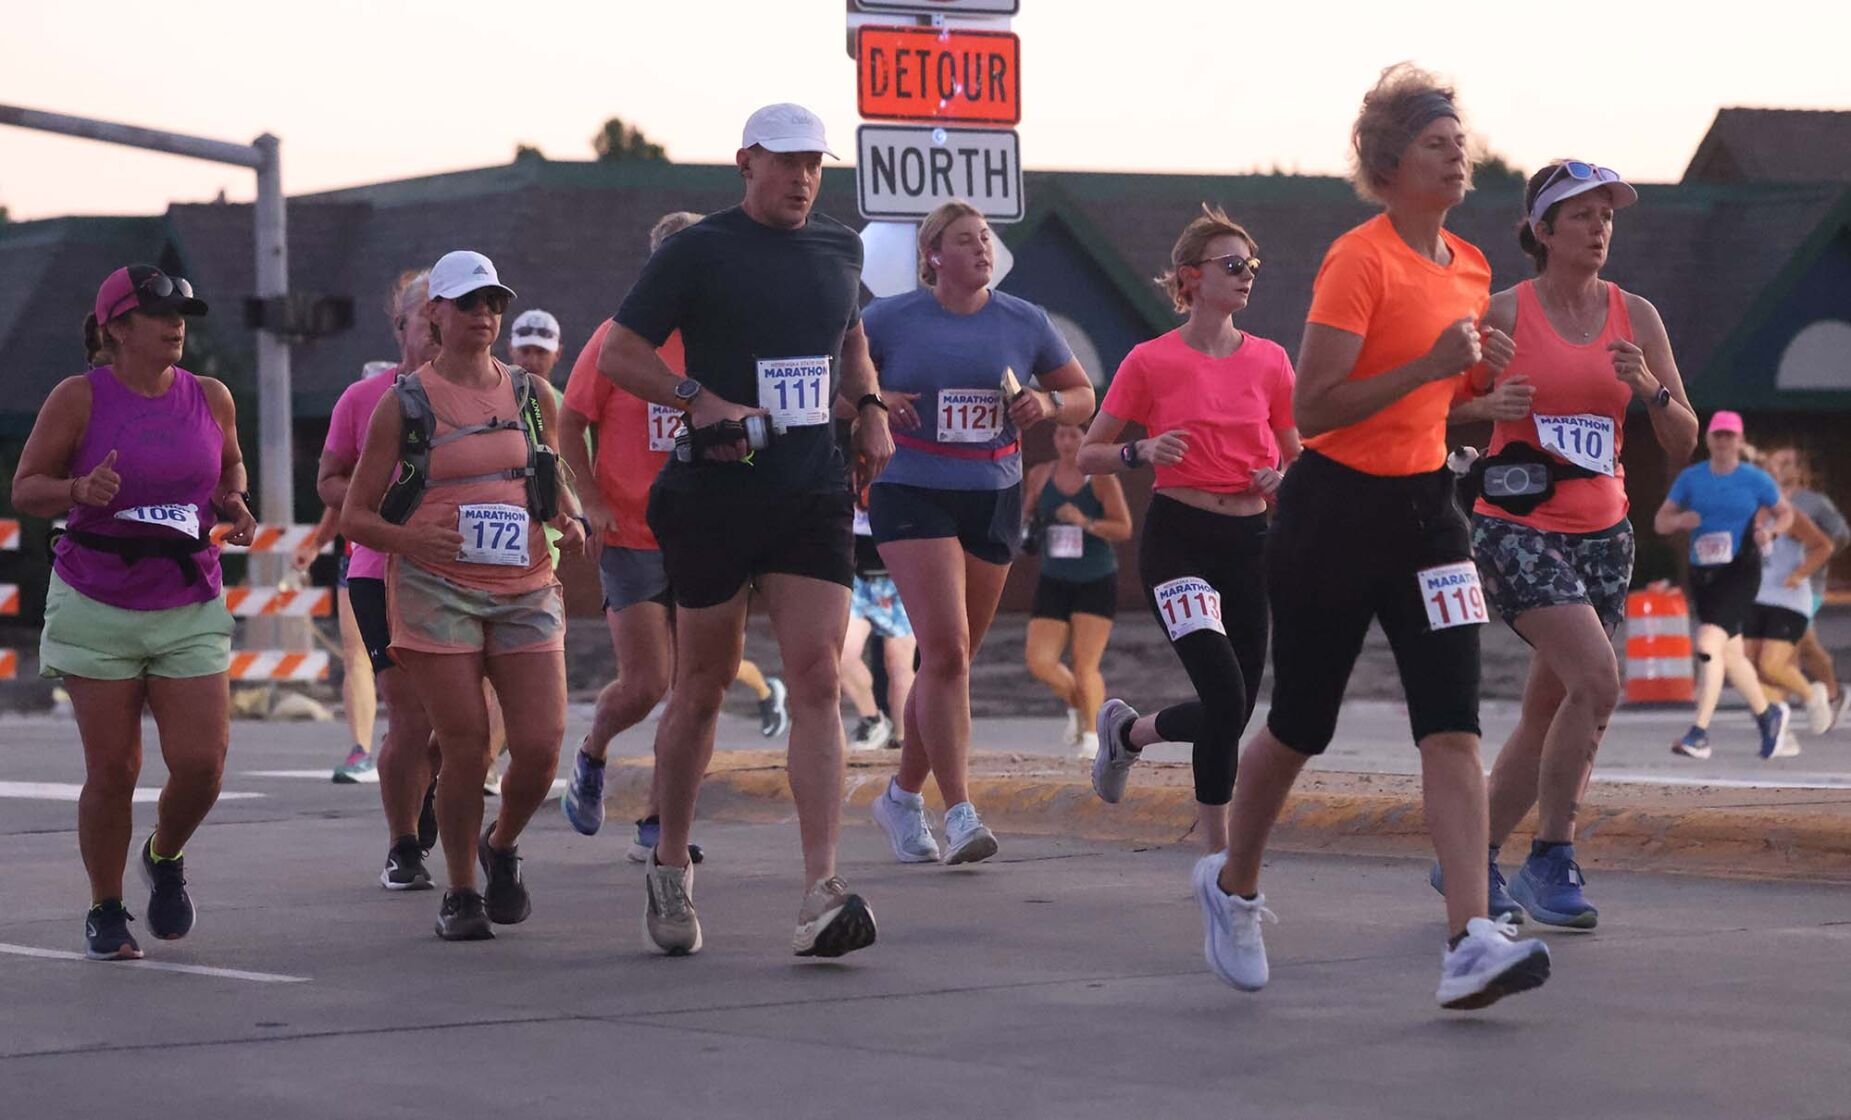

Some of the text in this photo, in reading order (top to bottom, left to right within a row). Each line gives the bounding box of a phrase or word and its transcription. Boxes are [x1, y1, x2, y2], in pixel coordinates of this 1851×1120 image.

[870, 47, 1007, 102] DETOUR
[871, 146, 1009, 198] NORTH
[764, 366, 828, 378] MARATHON
[774, 378, 820, 410] 111
[942, 405, 998, 429] 1121
[1540, 417, 1610, 432] MARATHON
[1552, 425, 1602, 459] 110
[137, 507, 187, 522] 106
[465, 510, 525, 521] MARATHON
[472, 521, 521, 550] 172
[1162, 592, 1220, 625] 1113
[1431, 586, 1484, 624] 119
